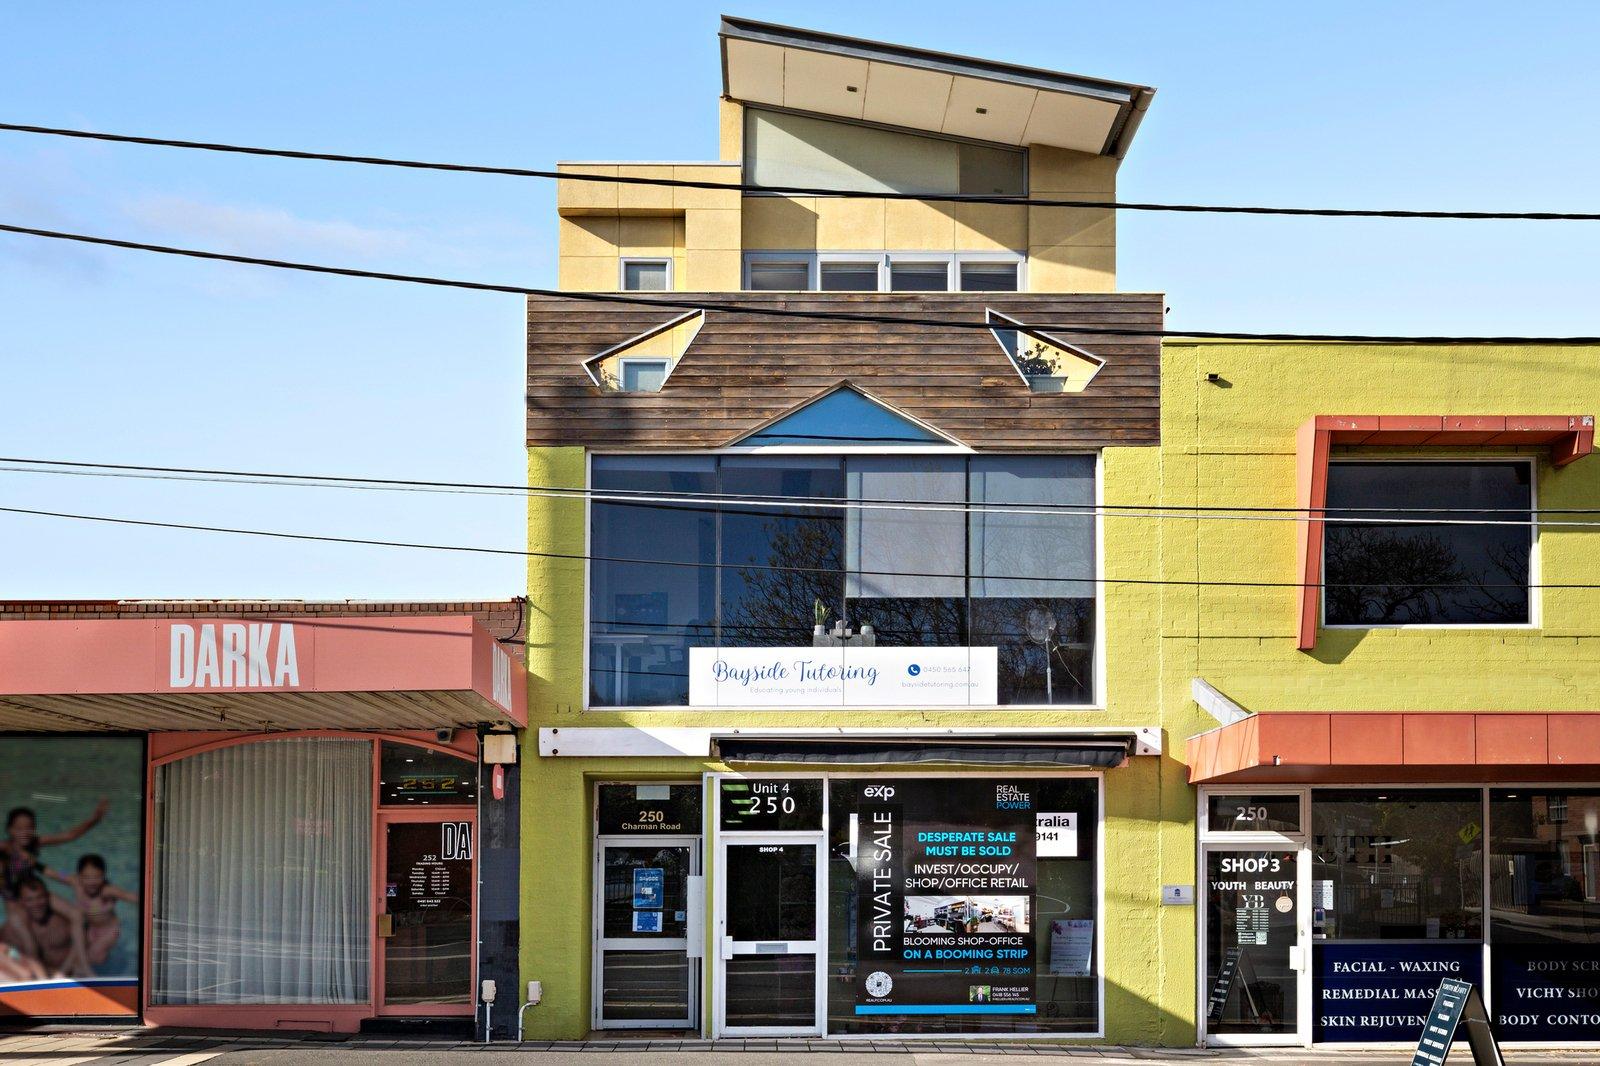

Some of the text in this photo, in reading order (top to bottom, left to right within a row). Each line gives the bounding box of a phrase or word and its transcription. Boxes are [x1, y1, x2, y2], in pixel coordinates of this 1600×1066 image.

[170, 624, 300, 687] DARKA
[712, 660, 880, 686] Bayside Tutoring
[901, 681, 979, 690] baysidetutoring.comau
[403, 777, 455, 790] 252
[753, 783, 790, 794] Unit 4
[996, 785, 1020, 793] REAL
[996, 793, 1030, 802] ESTATE
[749, 796, 796, 814] 250
[996, 801, 1031, 810] POWER
[638, 811, 664, 823] 250
[1235, 807, 1268, 820] 250
[1035, 815, 1070, 827] ralia
[621, 823, 681, 831] Charman Road
[441, 823, 472, 860] DA
[918, 832, 1017, 843] DESPERATE SALE
[925, 846, 1012, 856] MUST BE SOLD
[914, 862, 1020, 876] INVEST/OCCUPY/
[1221, 858, 1280, 873] SHOP 3
[873, 812, 892, 951] PRIVATE SALE
[905, 877, 1029, 890] SHOP/OFFICE RETAIL
[1211, 881, 1295, 891] YOUTH BEAUTY
[903, 936, 1024, 946] BLOOMING SHOP-OFFICE
[903, 949, 1029, 960] ON A BOOMING STRIP
[964, 967, 1031, 975] 2 2 78 SQM
[1333, 961, 1386, 973] FACIAL
[1399, 961, 1461, 973] WAXING
[1527, 960, 1568, 971] BODY
[1322, 988, 1401, 999] REMEDIAL
[1516, 987, 1565, 998] VICHY
[1320, 1015, 1357, 1026] SKIN
[1500, 1014, 1539, 1025] BODY
